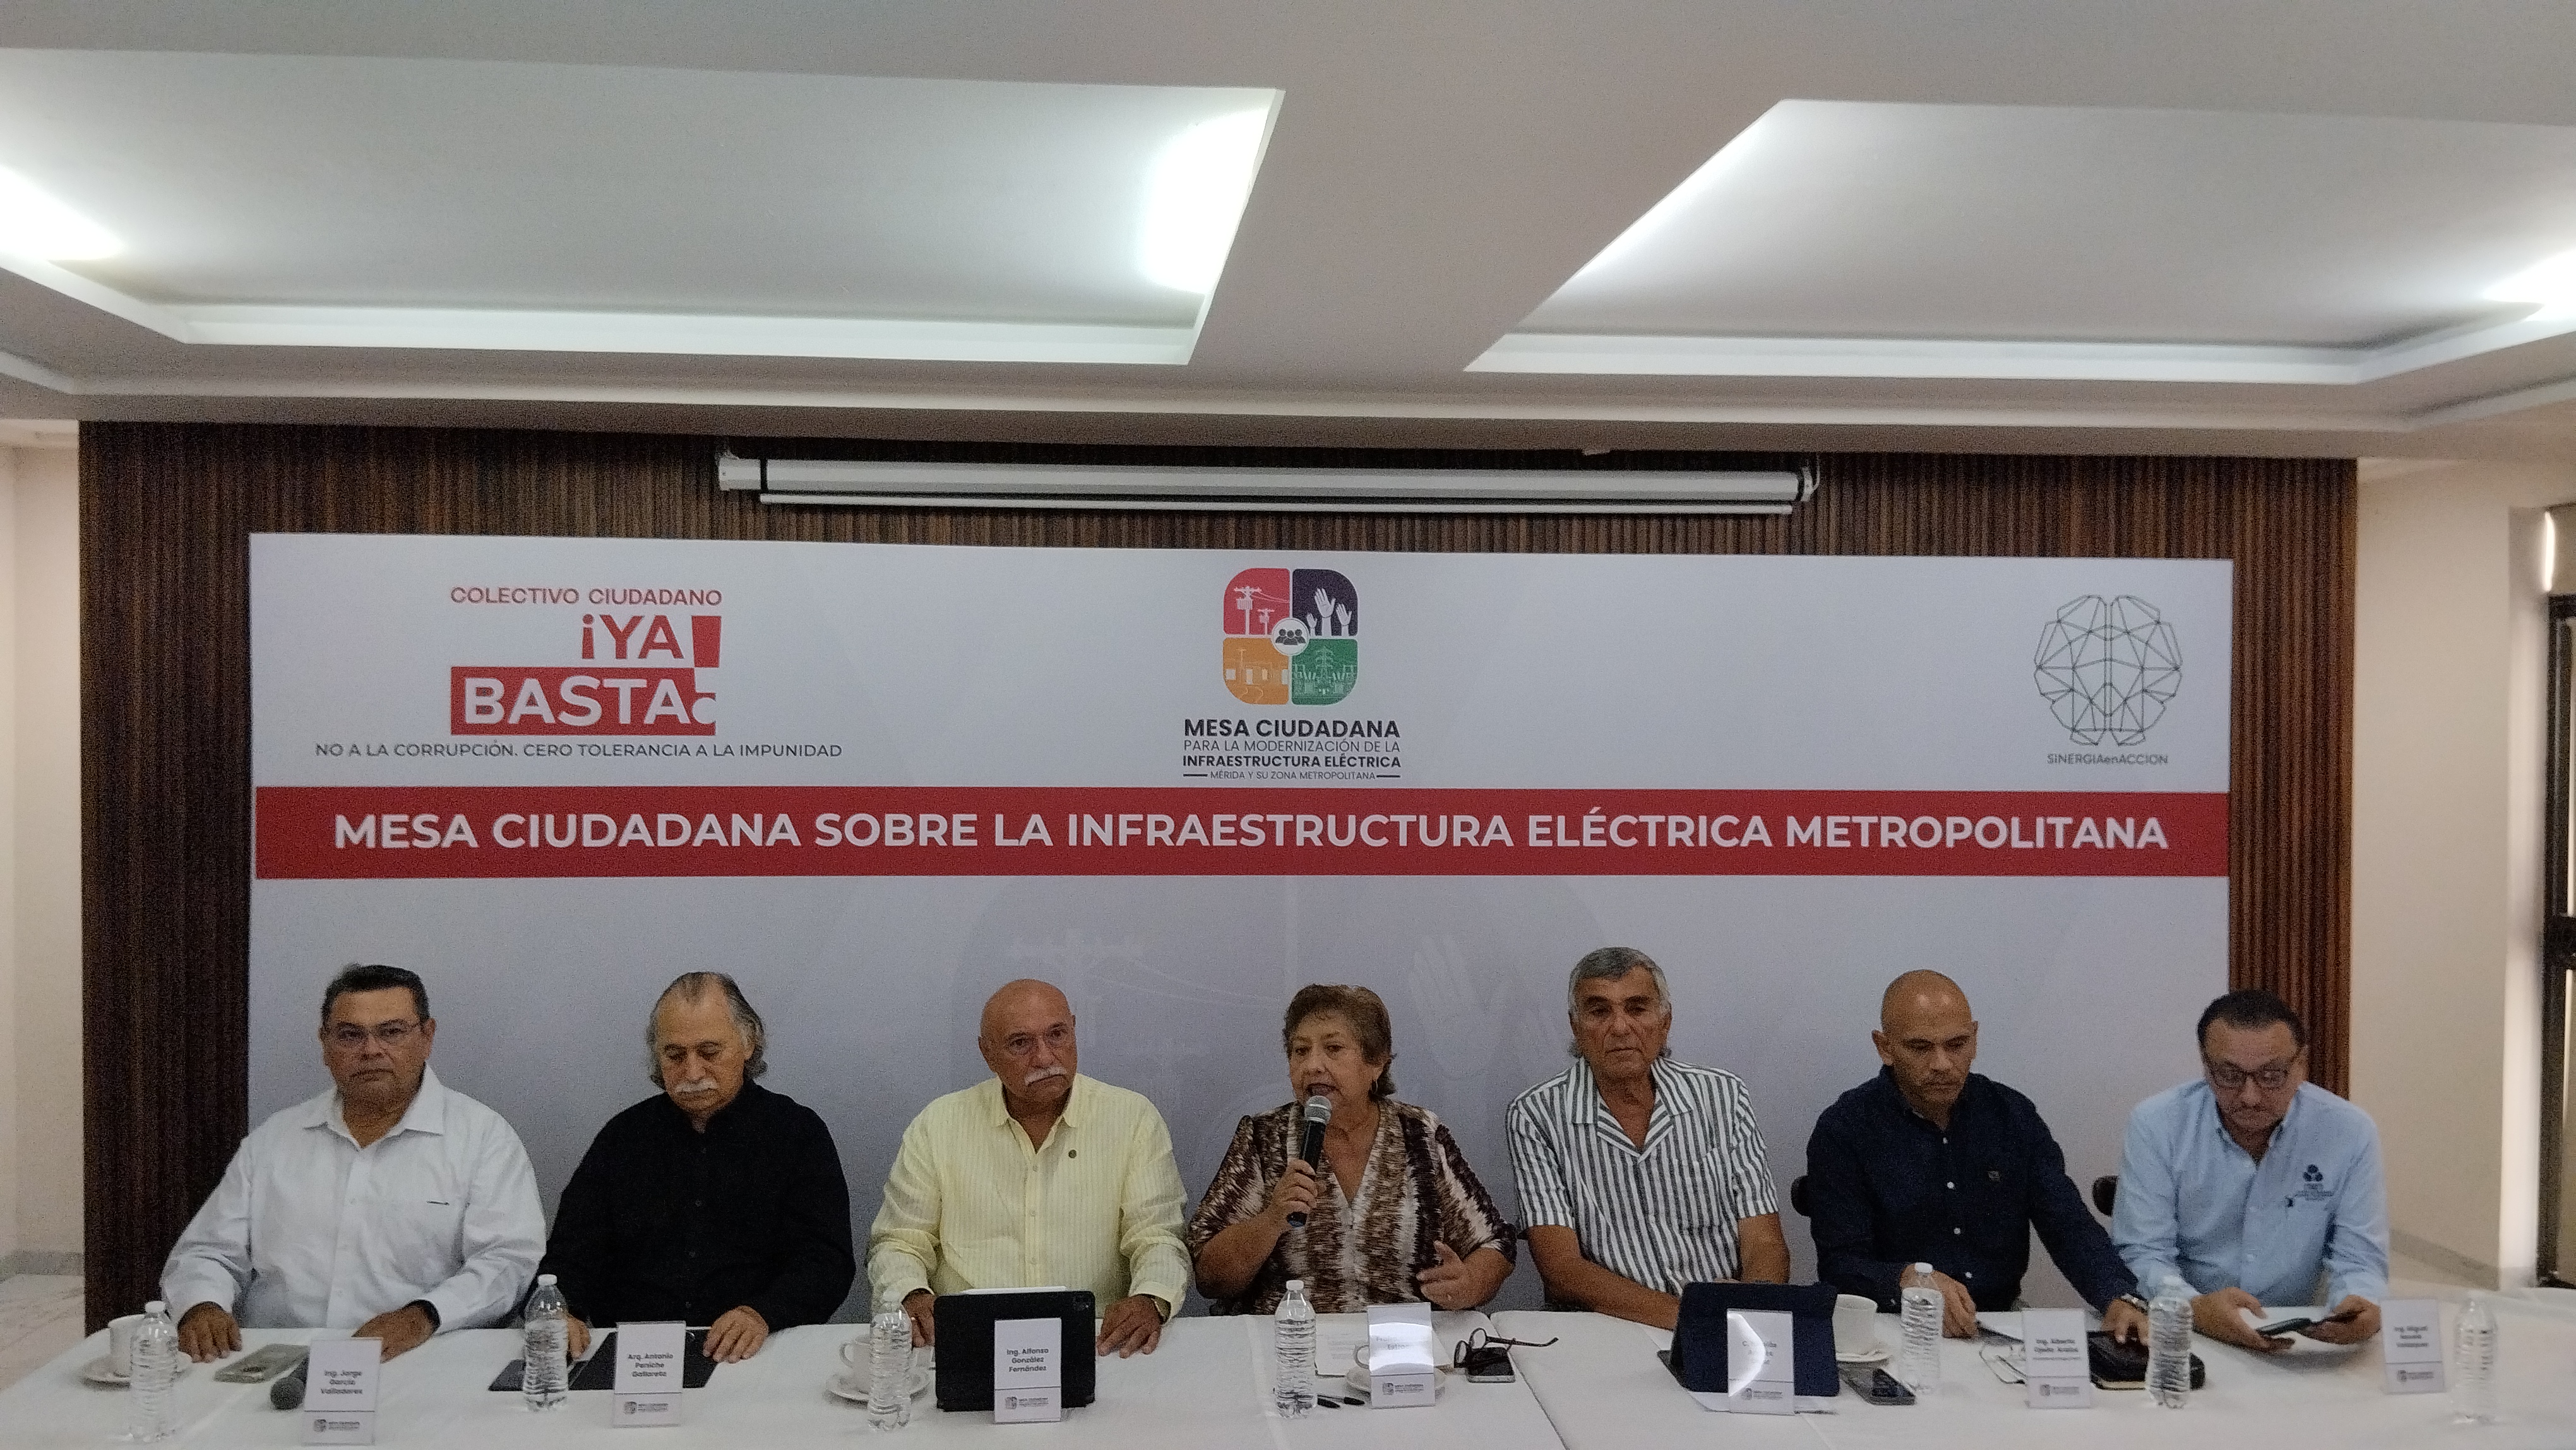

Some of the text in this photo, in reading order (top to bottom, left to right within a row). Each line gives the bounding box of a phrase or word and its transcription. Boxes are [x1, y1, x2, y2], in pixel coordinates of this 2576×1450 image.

[450, 586, 722, 606] COLECTIVO CIUDADANO
[1184, 719, 1400, 738] MESA CIUDADANA
[315, 740, 842, 757] NO A LA CORRUPCIÓN. CERO TOLERANCIA A LA IMPUNIDAD
[1183, 738, 1400, 753] PARA LA MODERNIZACIÓN DE LA
[1183, 753, 1401, 768] INFRAESTRUCTURA ELÉCTRICA
[1210, 769, 1376, 780] MÉRIDA Y SU ZONA METROPOLITANA
[335, 806, 2169, 849] MESA CIUDADANA SOBRE LA INFRAESTRUCTURA ELÉCTRICA METROPOLITANA
